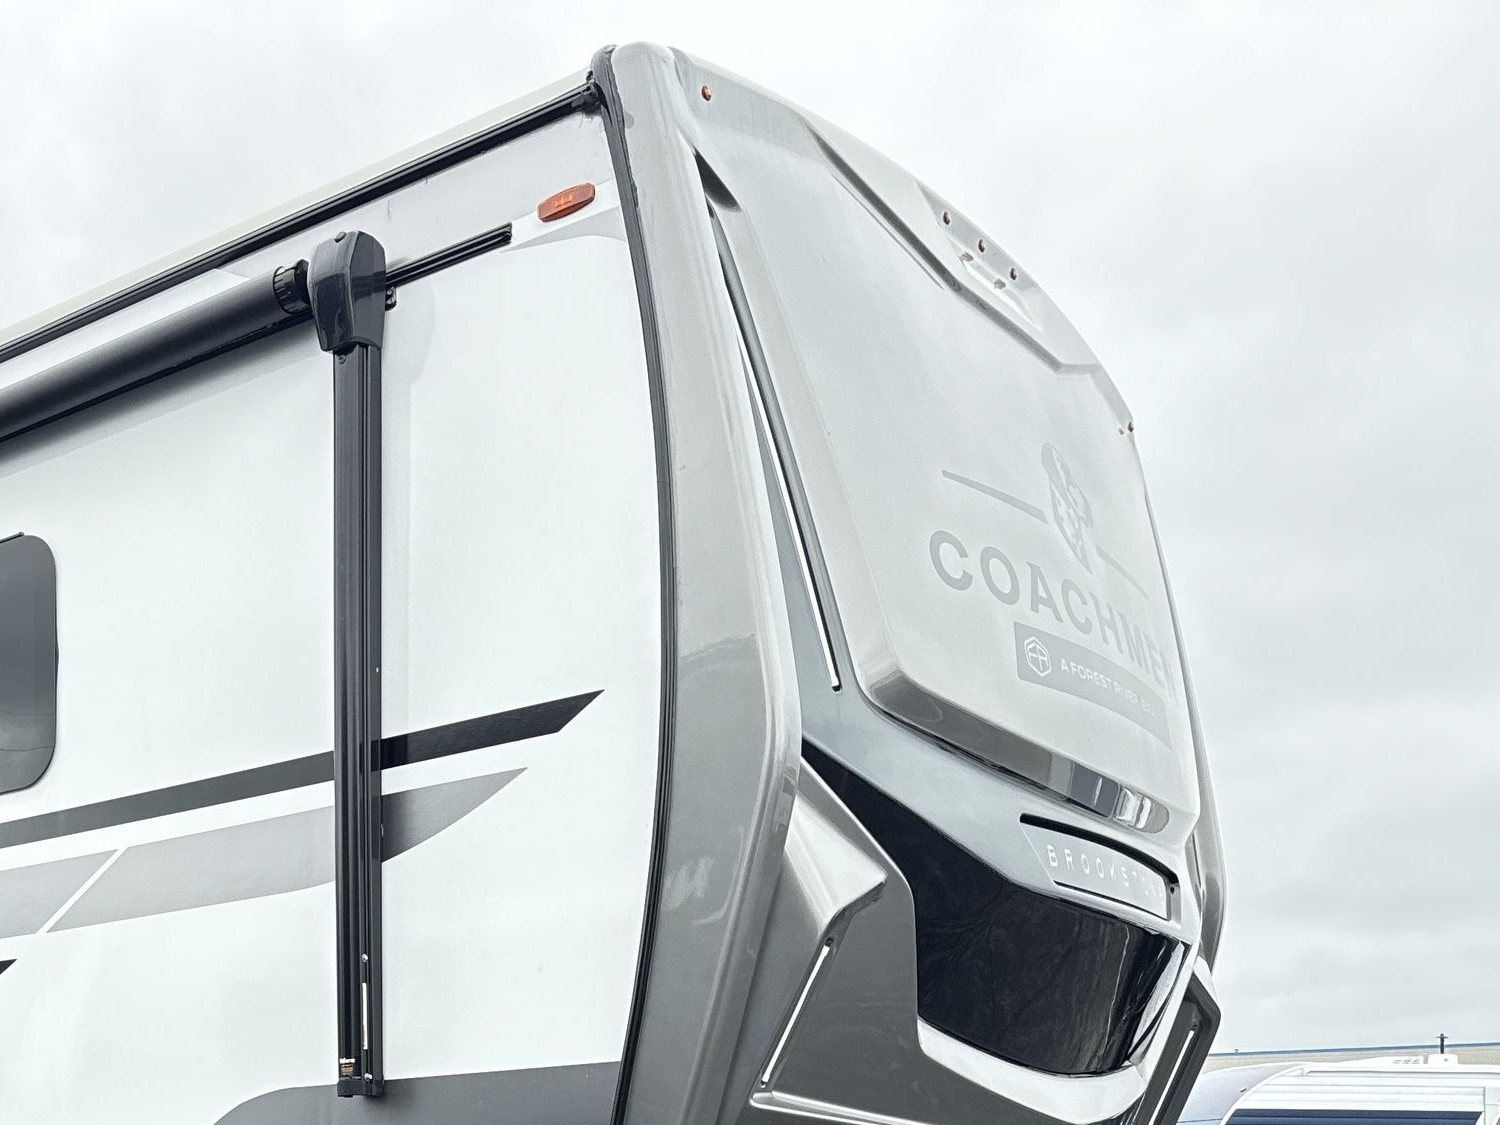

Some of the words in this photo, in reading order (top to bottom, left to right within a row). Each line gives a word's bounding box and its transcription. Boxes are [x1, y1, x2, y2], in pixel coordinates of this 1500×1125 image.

[928, 530, 1179, 705] COACHMEN
[1061, 658, 1069, 672] A
[1070, 662, 1114, 690] FOREST
